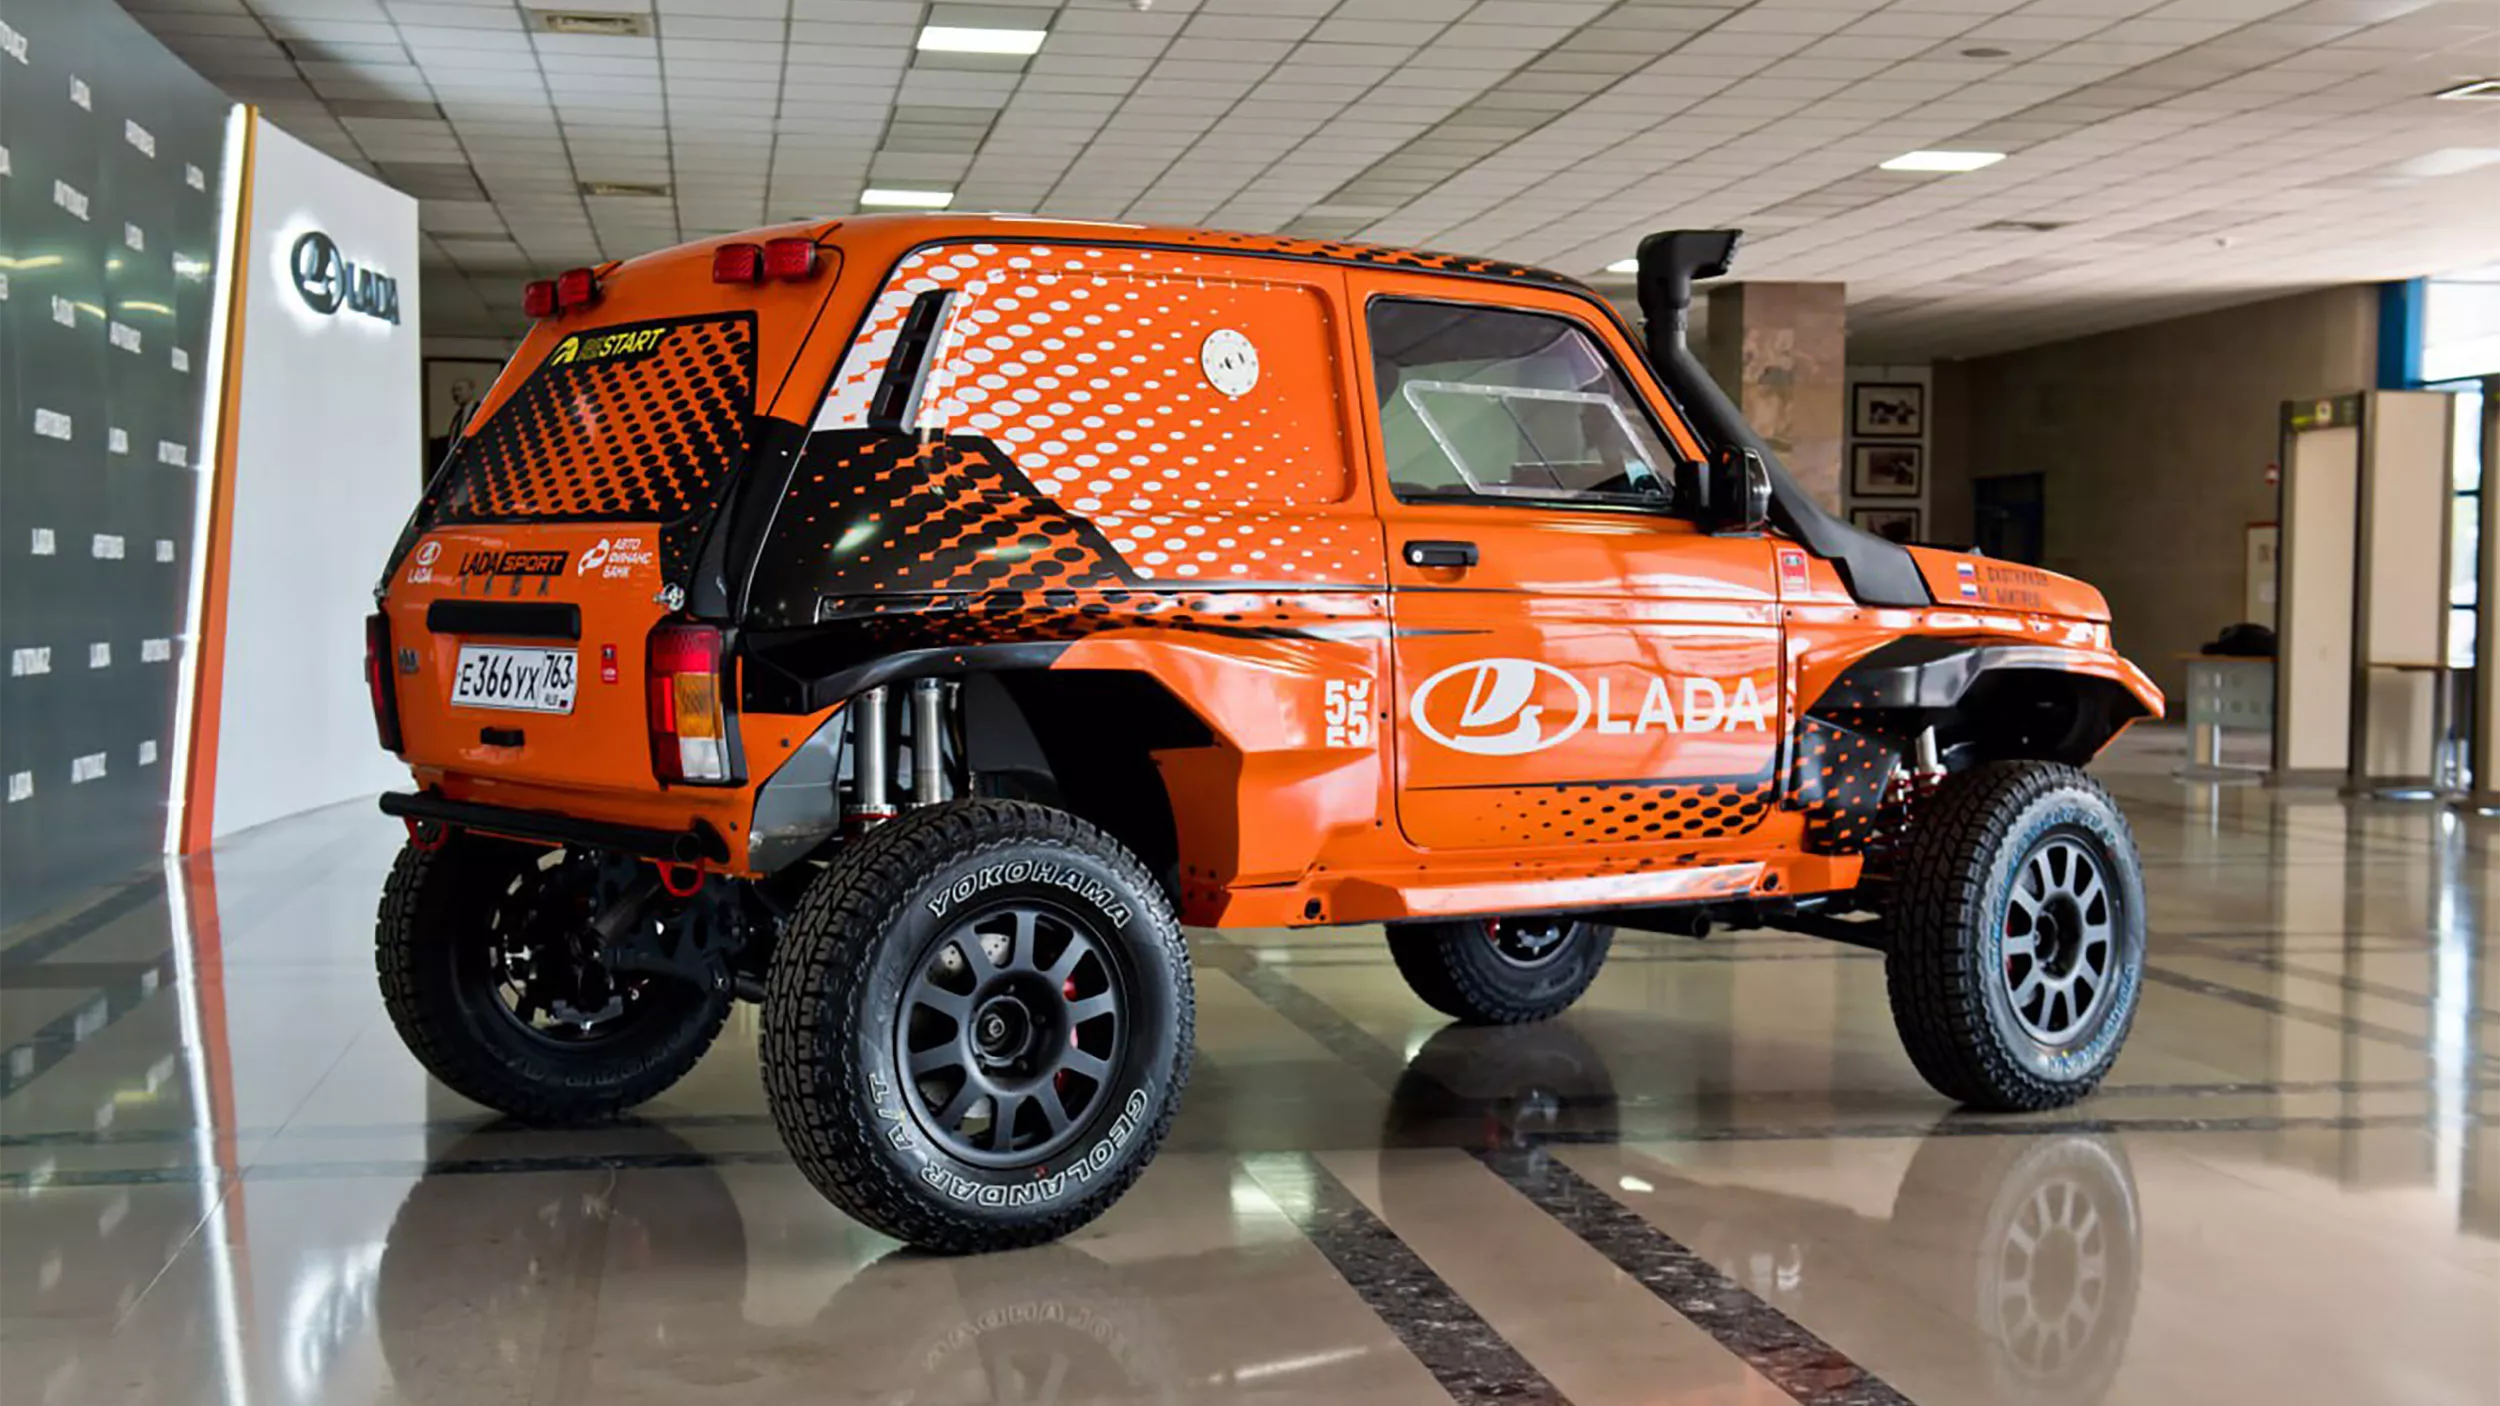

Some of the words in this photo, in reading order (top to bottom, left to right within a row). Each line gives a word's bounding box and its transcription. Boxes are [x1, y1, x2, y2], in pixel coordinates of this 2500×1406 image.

[345, 261, 400, 325] LADA
[458, 552, 500, 576] LADA
[502, 554, 564, 574] SPORT
[543, 654, 573, 689] 763
[1597, 676, 1767, 735] LADA
[928, 860, 1133, 929] YOKOHAMA
[921, 1088, 1148, 1207] GEOLANDAR
